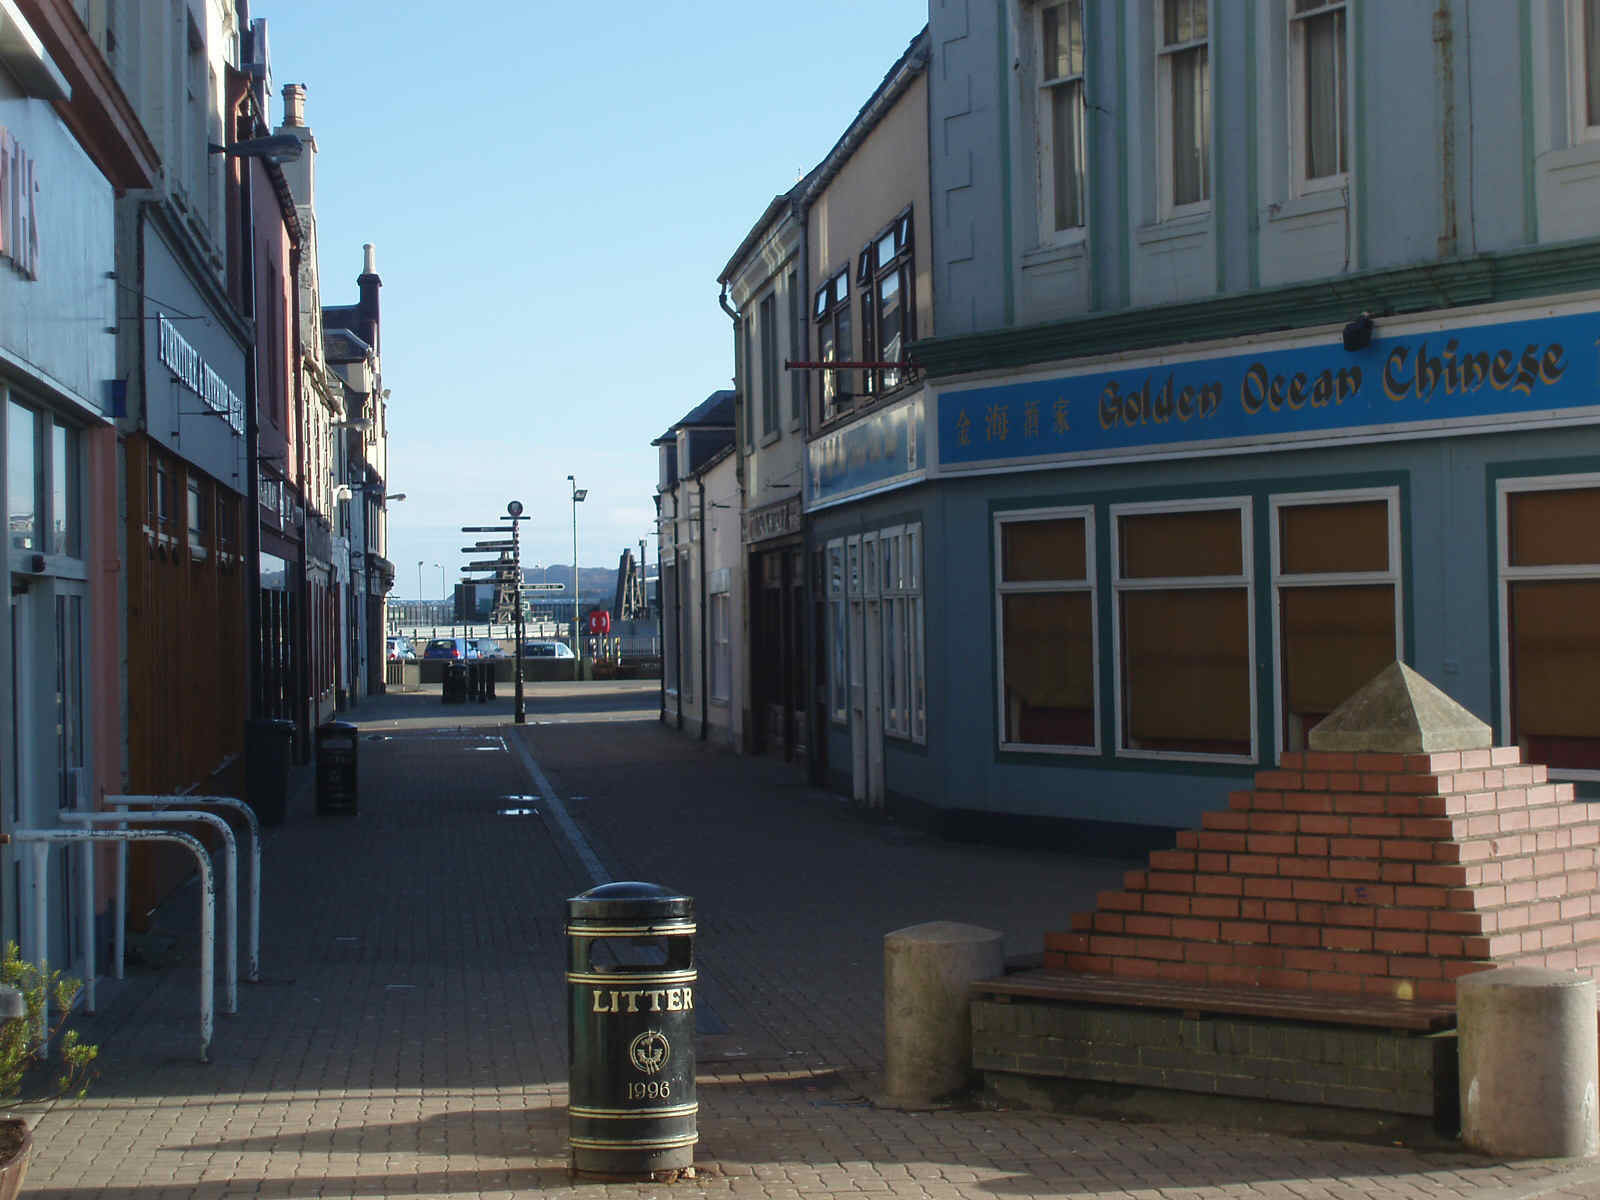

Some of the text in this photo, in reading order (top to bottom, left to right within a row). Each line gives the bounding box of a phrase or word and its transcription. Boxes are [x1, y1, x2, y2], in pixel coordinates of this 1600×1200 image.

[1098, 370, 1223, 430] Golden
[1241, 362, 1362, 414] Ocean
[1384, 338, 1568, 403] Chinese
[593, 987, 694, 1013] LITTER
[628, 1082, 671, 1100] 1996
